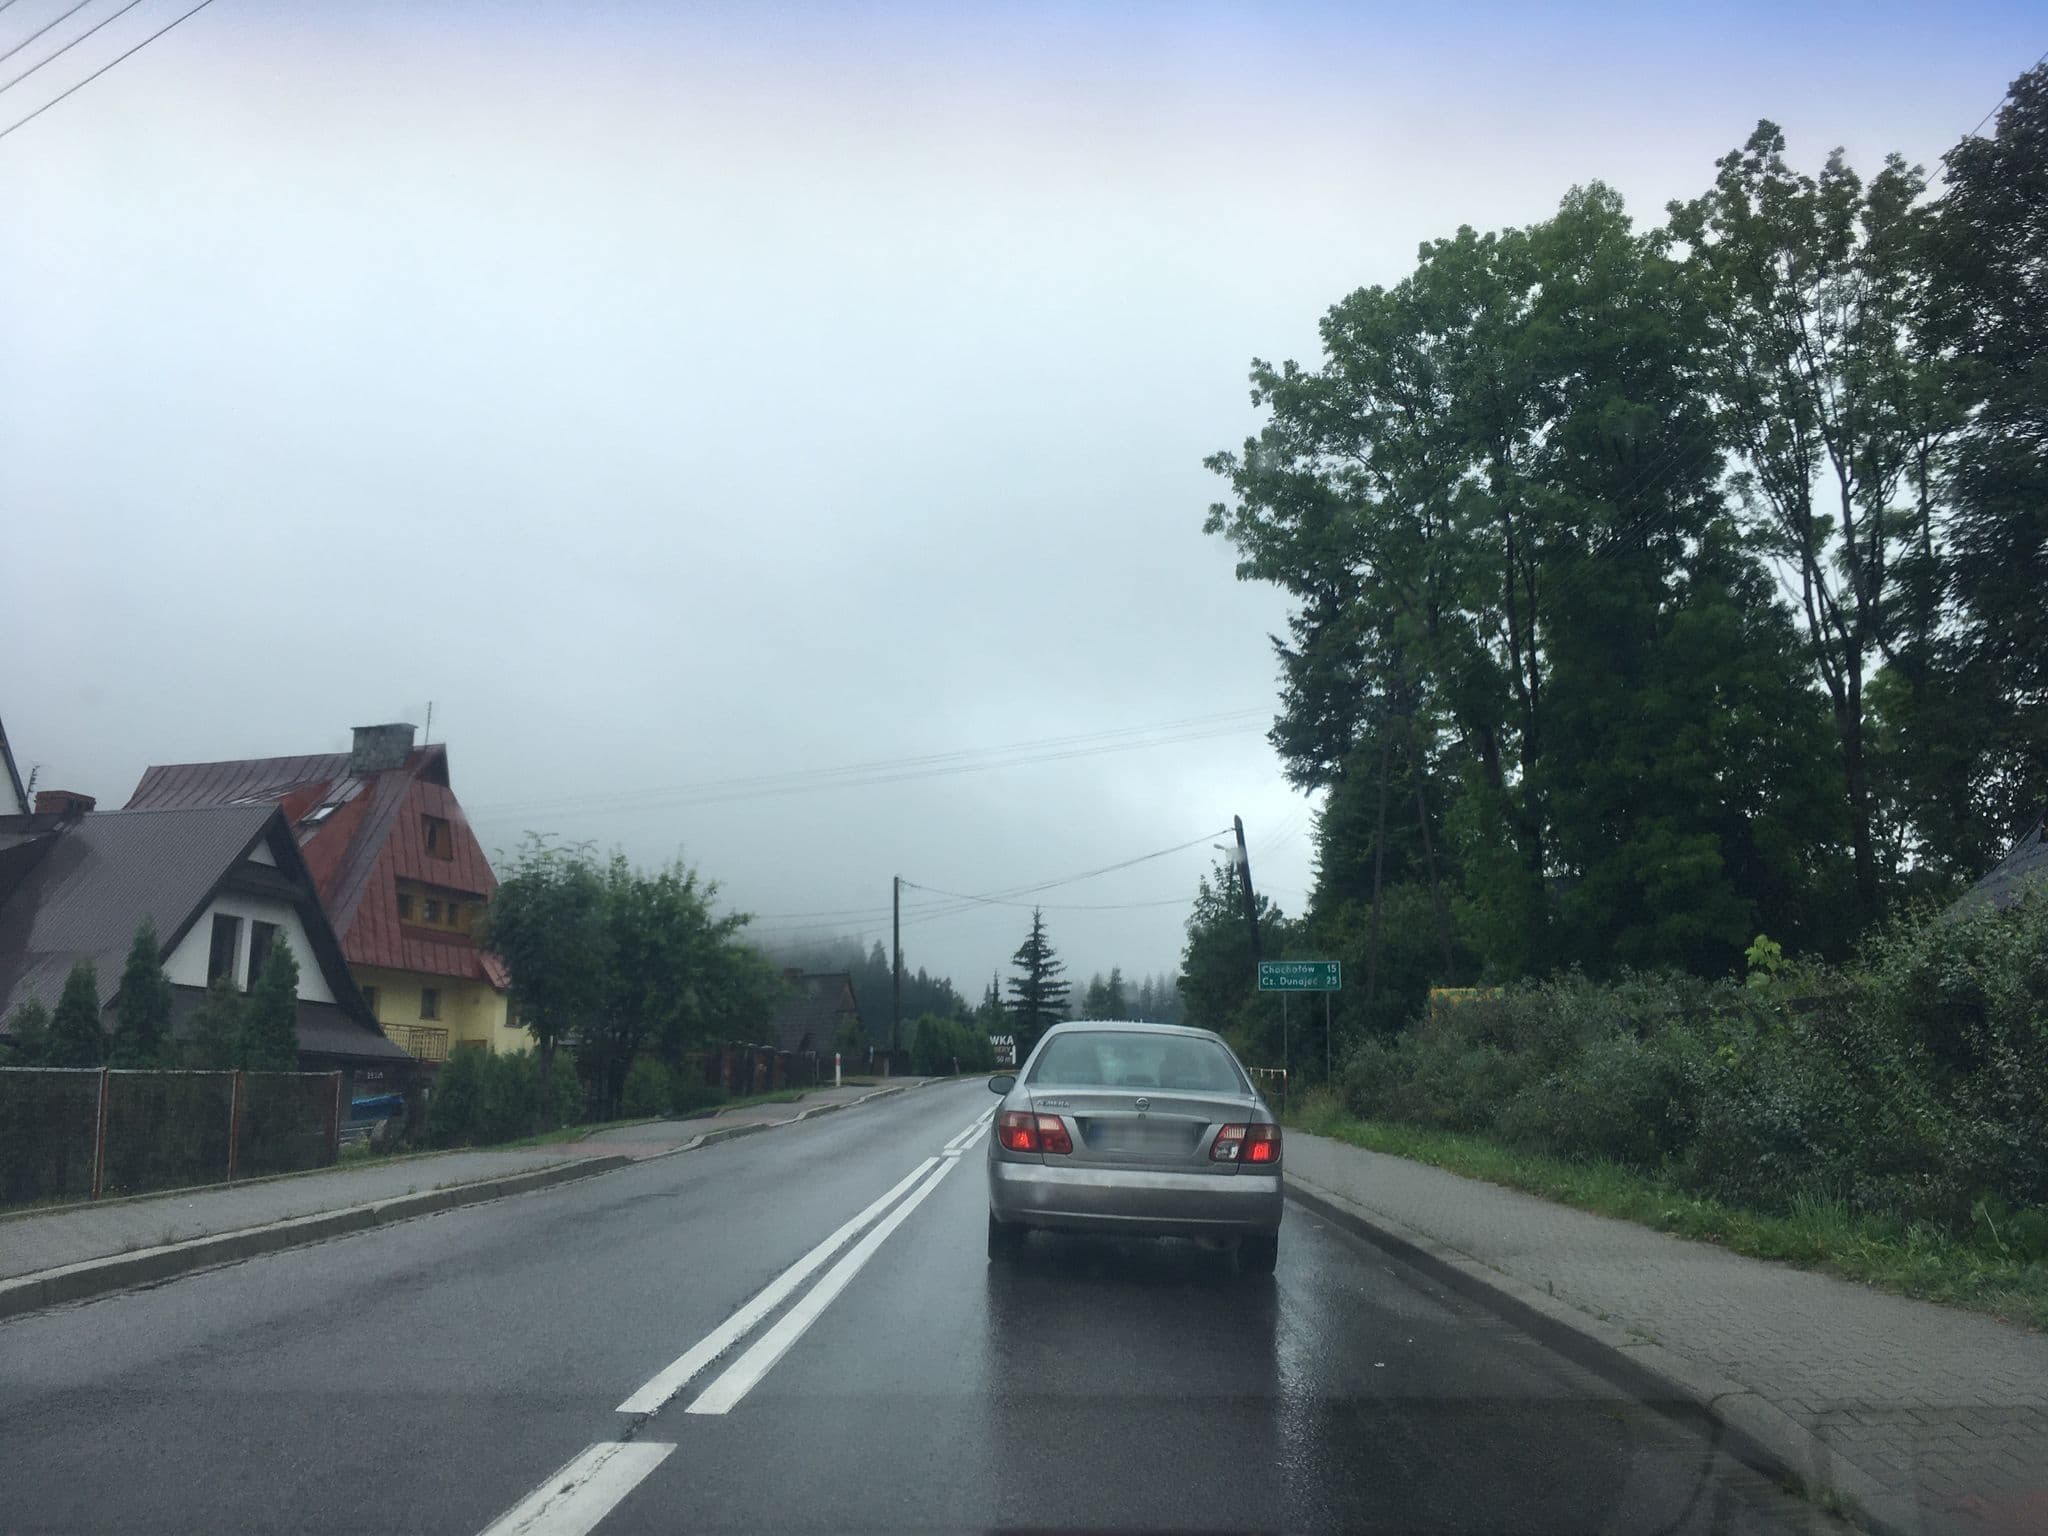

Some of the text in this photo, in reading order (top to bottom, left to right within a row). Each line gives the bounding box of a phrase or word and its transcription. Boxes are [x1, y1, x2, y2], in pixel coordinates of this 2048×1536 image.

[1327, 964, 1337, 974] 15
[1280, 976, 1318, 988] Dunajec
[1326, 976, 1338, 985] 25
